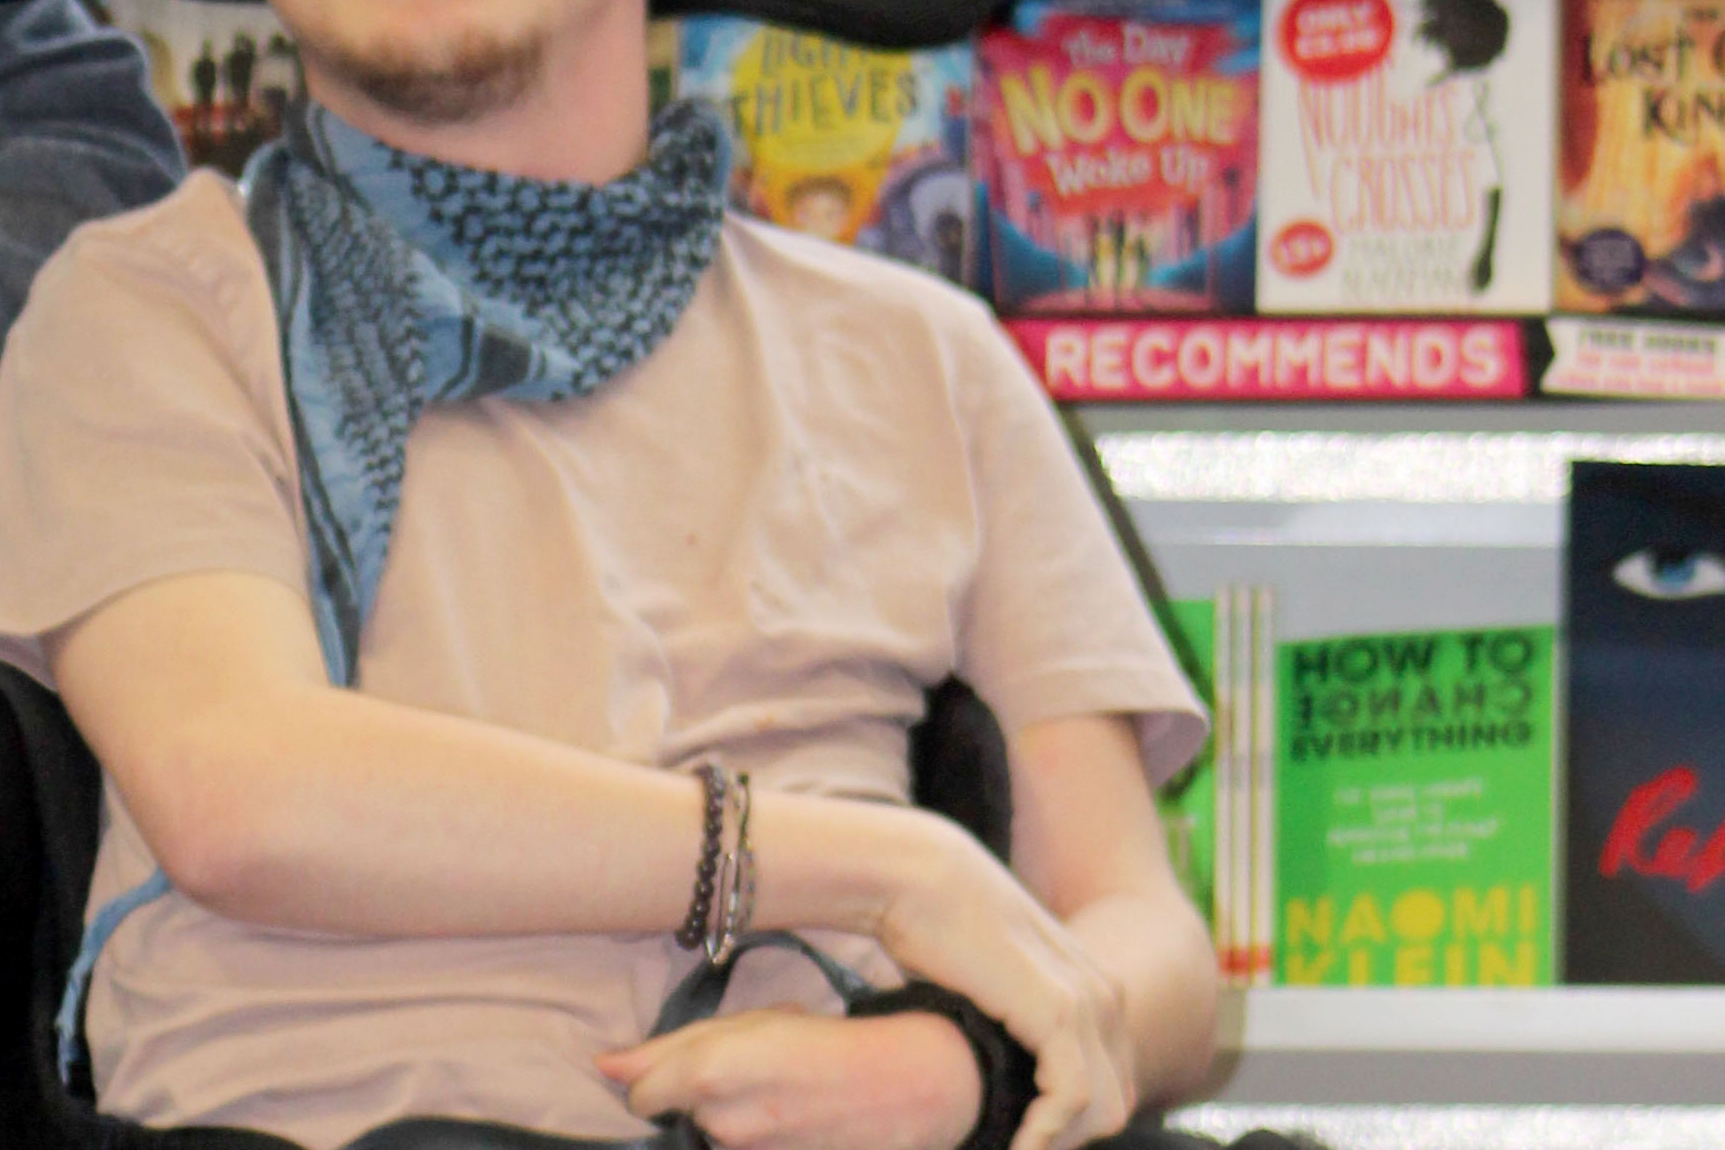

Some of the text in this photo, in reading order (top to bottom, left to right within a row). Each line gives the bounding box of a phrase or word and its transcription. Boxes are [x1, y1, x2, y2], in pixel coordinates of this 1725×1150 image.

[730, 67, 918, 138] THIEVES
[999, 62, 1241, 158] NO ONE
[1329, 147, 1475, 235] CROSSES
[1044, 321, 1507, 392] RECOMMENDS
[1291, 628, 1534, 684] HOW TO
[1290, 722, 1534, 760] EVERYTHING
[1285, 886, 1537, 946] NAOMI
